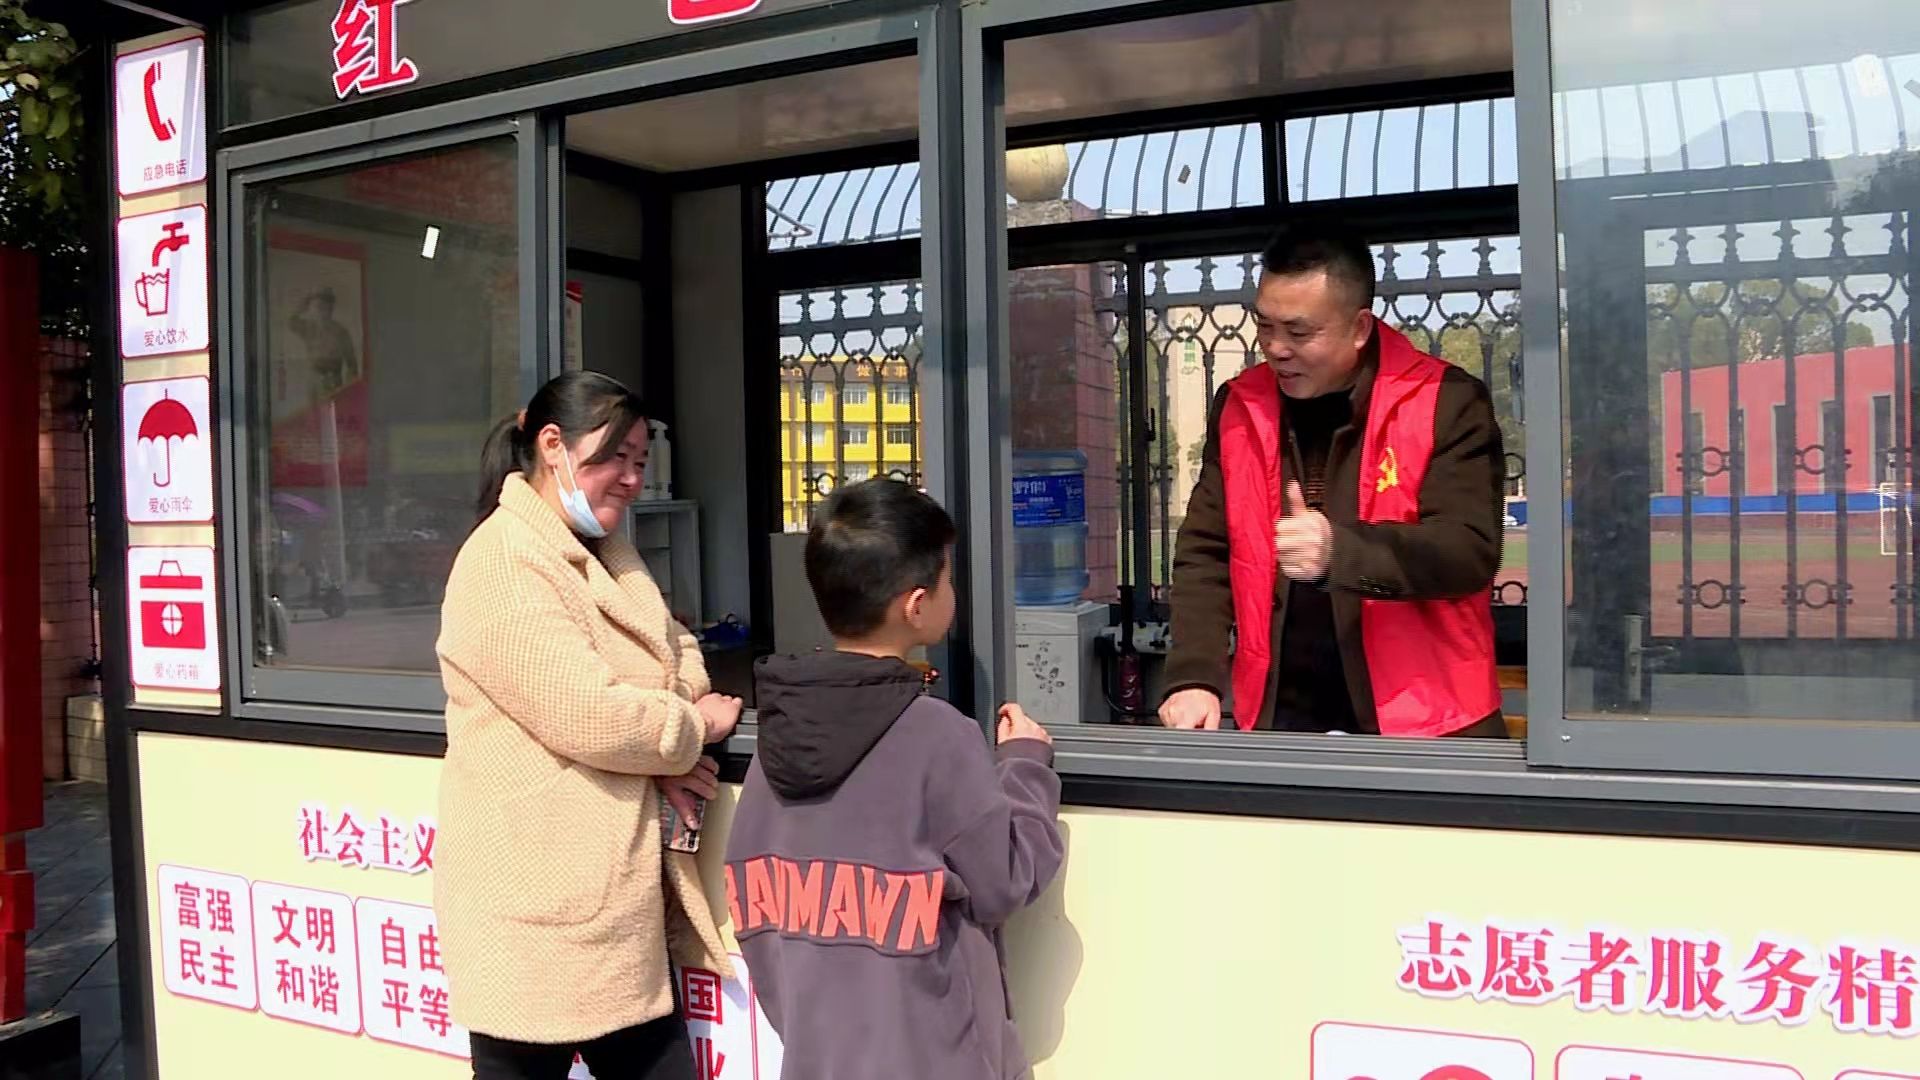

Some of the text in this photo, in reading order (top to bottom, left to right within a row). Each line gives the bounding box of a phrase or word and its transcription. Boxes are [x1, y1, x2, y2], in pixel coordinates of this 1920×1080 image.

[143, 159, 187, 182] 应急电话
[144, 327, 188, 348] 爱心饮水
[148, 496, 192, 514] 爱心雨伞
[297, 807, 437, 870] 社会主义
[173, 881, 235, 935] 富强
[271, 899, 336, 954] 文明
[179, 938, 239, 990] 民主
[380, 916, 445, 976] 自由
[275, 958, 340, 1016] 和谐
[1399, 920, 1920, 1030] 志愿者服务精
[382, 978, 453, 1038] 平等
